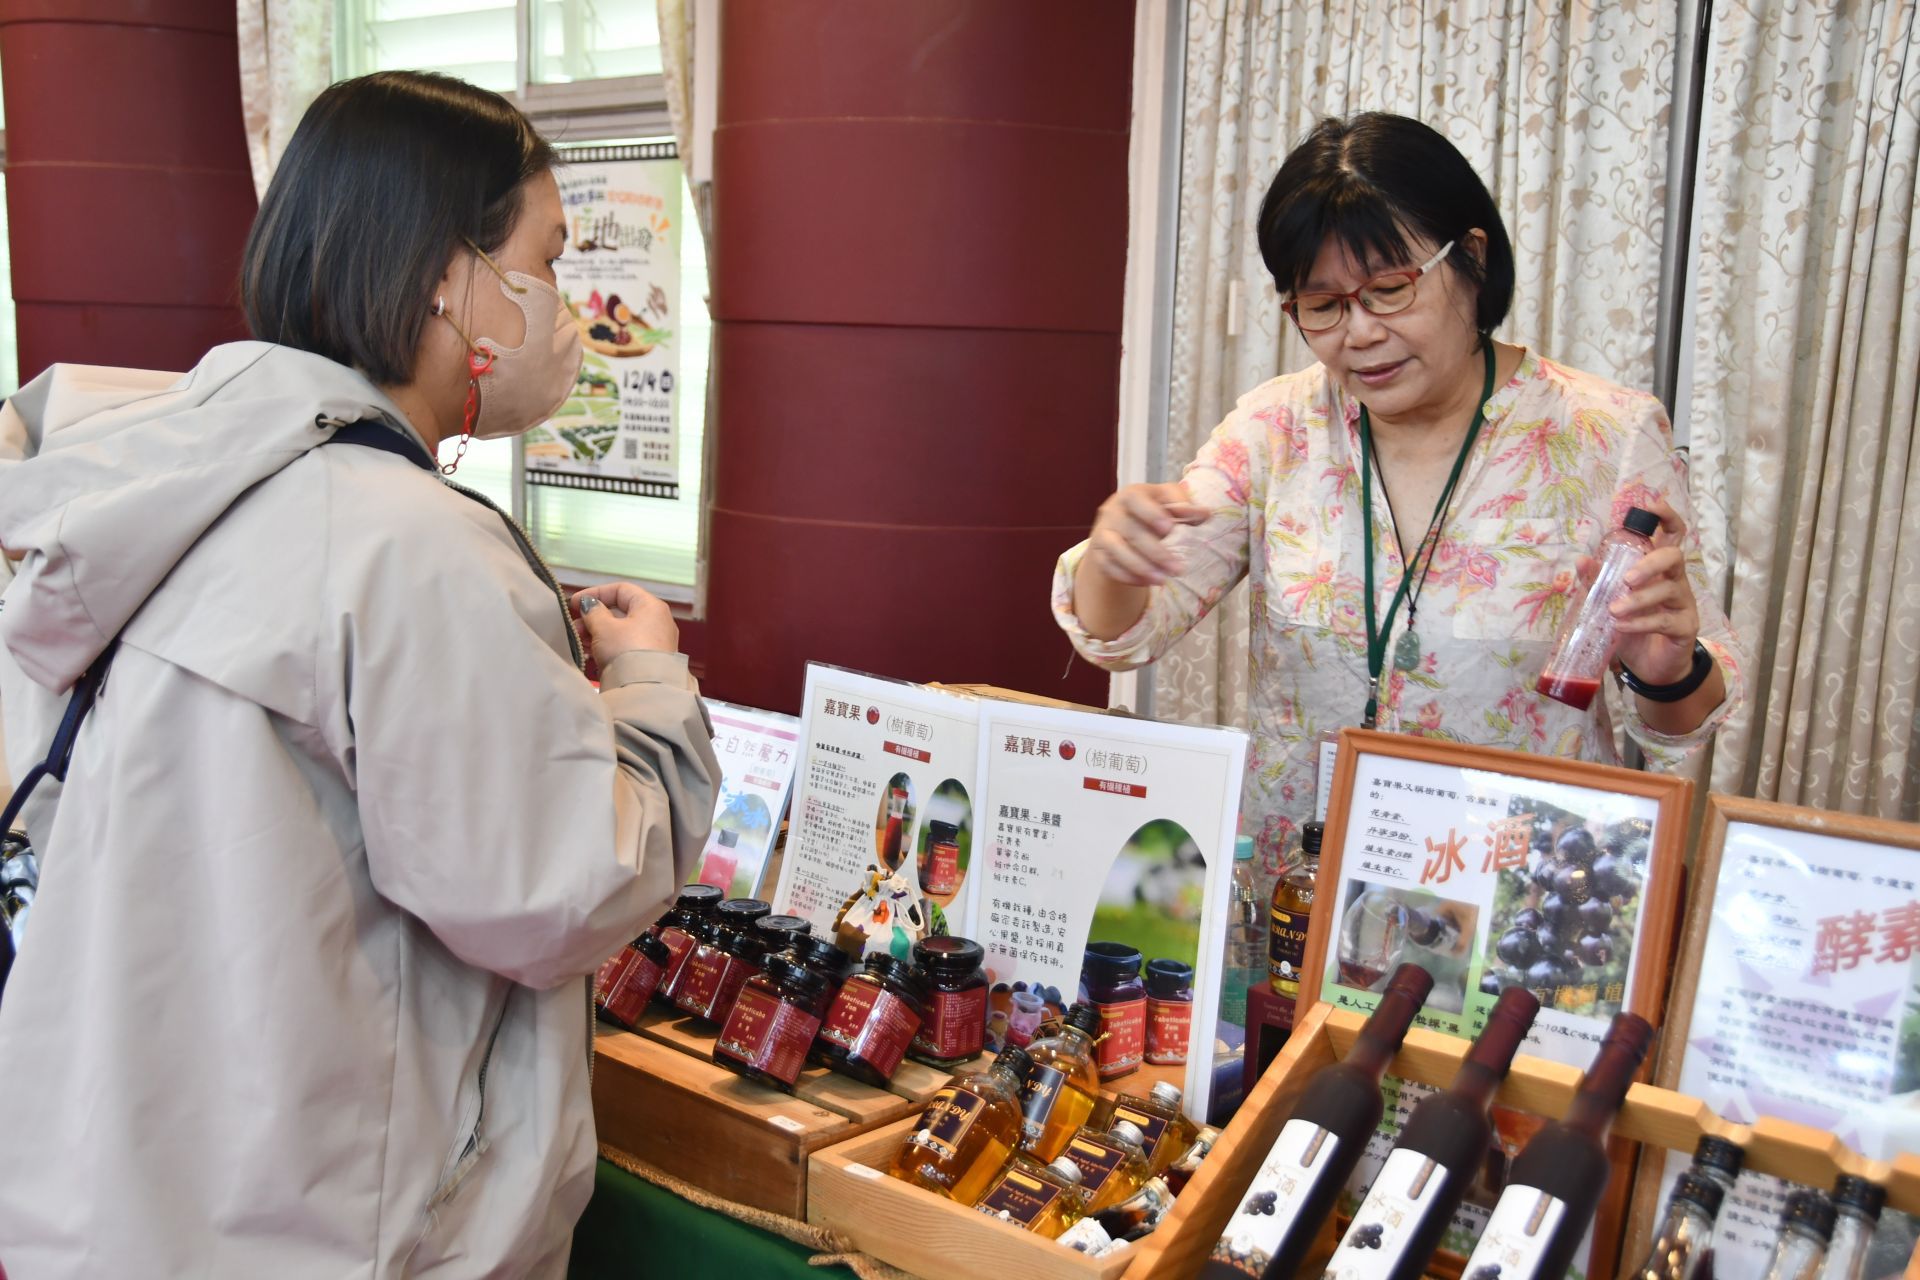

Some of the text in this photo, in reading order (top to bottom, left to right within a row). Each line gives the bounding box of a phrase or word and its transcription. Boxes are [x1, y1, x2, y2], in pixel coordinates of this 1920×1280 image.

[823, 698, 861, 720] 嘉寶果
[886, 714, 934, 742] (樹葡萄)
[1004, 735, 1051, 758] 嘉寶果
[1085, 747, 1148, 775] (樹葡萄)
[1099, 780, 1131, 795] 有機種植
[998, 804, 1030, 820] 嘉寶果
[1041, 811, 1062, 828] 果醬
[1419, 813, 1535, 885] 冰酒
[1811, 899, 1920, 977] 酵素
